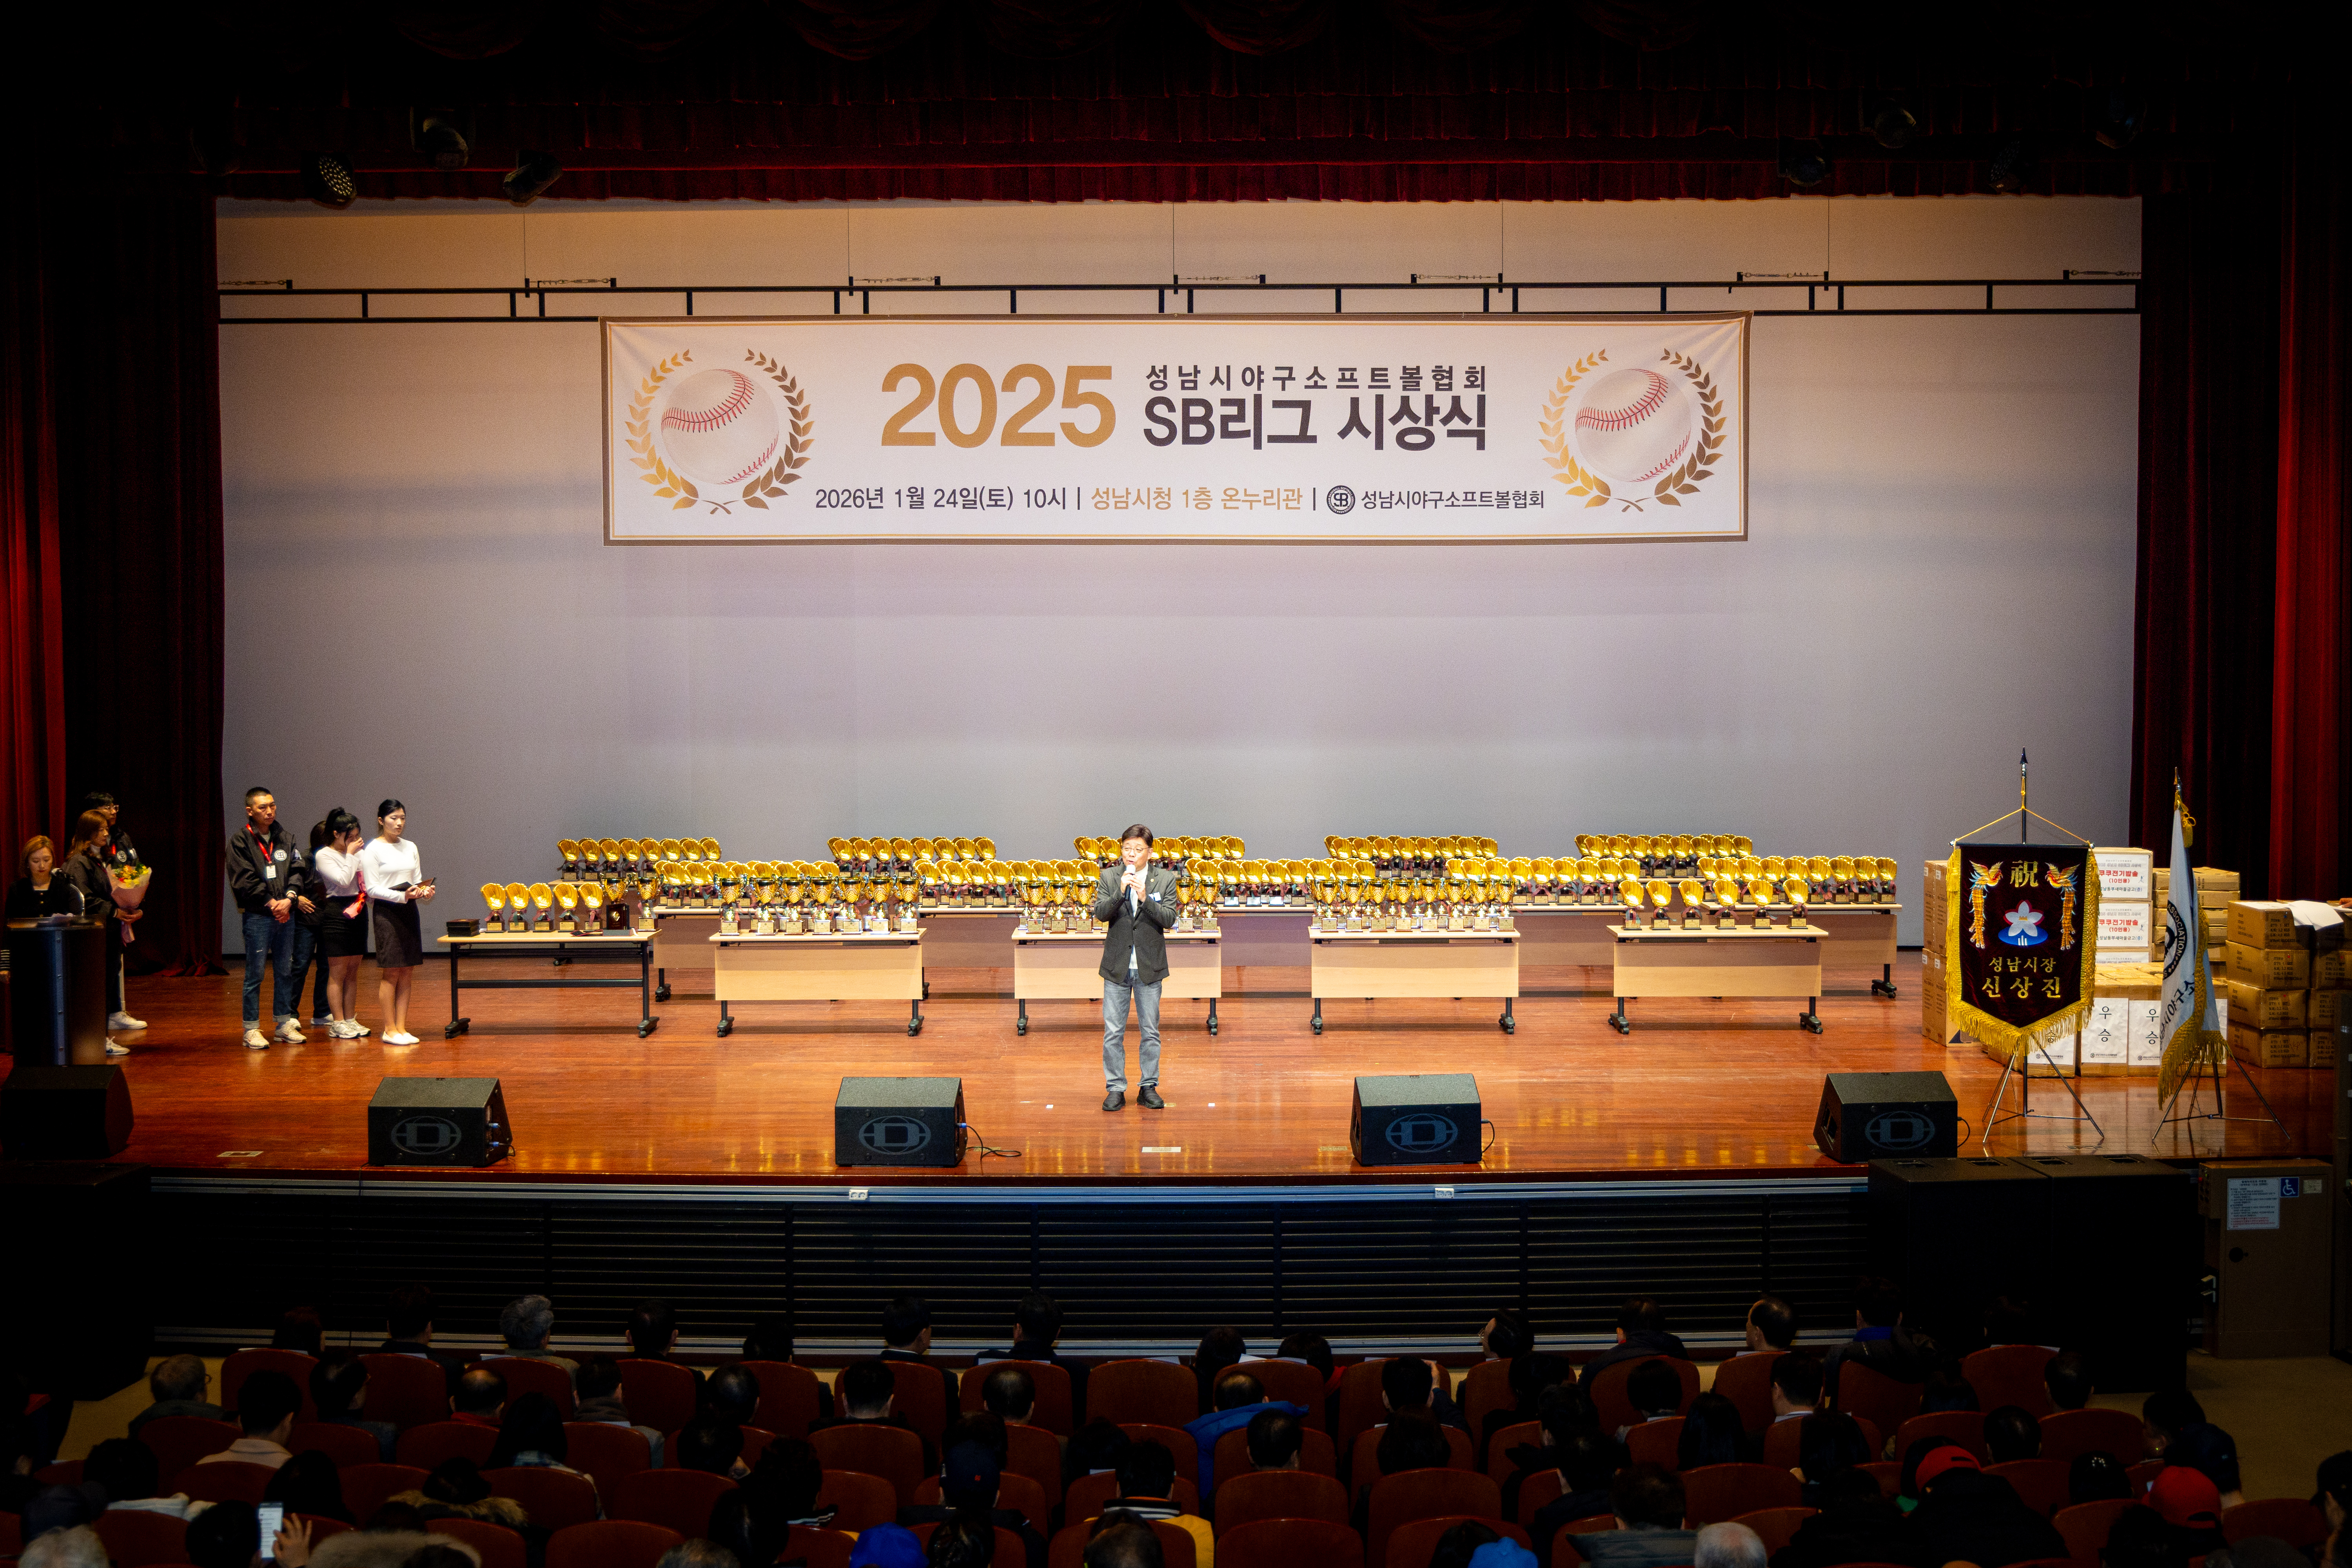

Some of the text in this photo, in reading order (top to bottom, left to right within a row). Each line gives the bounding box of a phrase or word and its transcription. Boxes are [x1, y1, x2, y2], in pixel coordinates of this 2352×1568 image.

[1146, 365, 1486, 392] 성남시야구소프트볼협회
[881, 363, 1116, 448] 2025
[1143, 394, 1486, 452] SB리그 시상식
[816, 486, 1065, 511] 2026년 1월 24일(토) 10시
[1091, 487, 1303, 510] 성남시청 1층 온누리관
[1361, 490, 1544, 510] 성남시야구소프트볼협회
[2010, 860, 2039, 887] 祝
[2167, 904, 2185, 956] ASSOCIATION
[1989, 956, 2056, 973] 성남시장
[1982, 976, 2061, 998] 신상진
[2098, 1006, 2112, 1042] 우승
[2145, 1009, 2159, 1044] 우승
